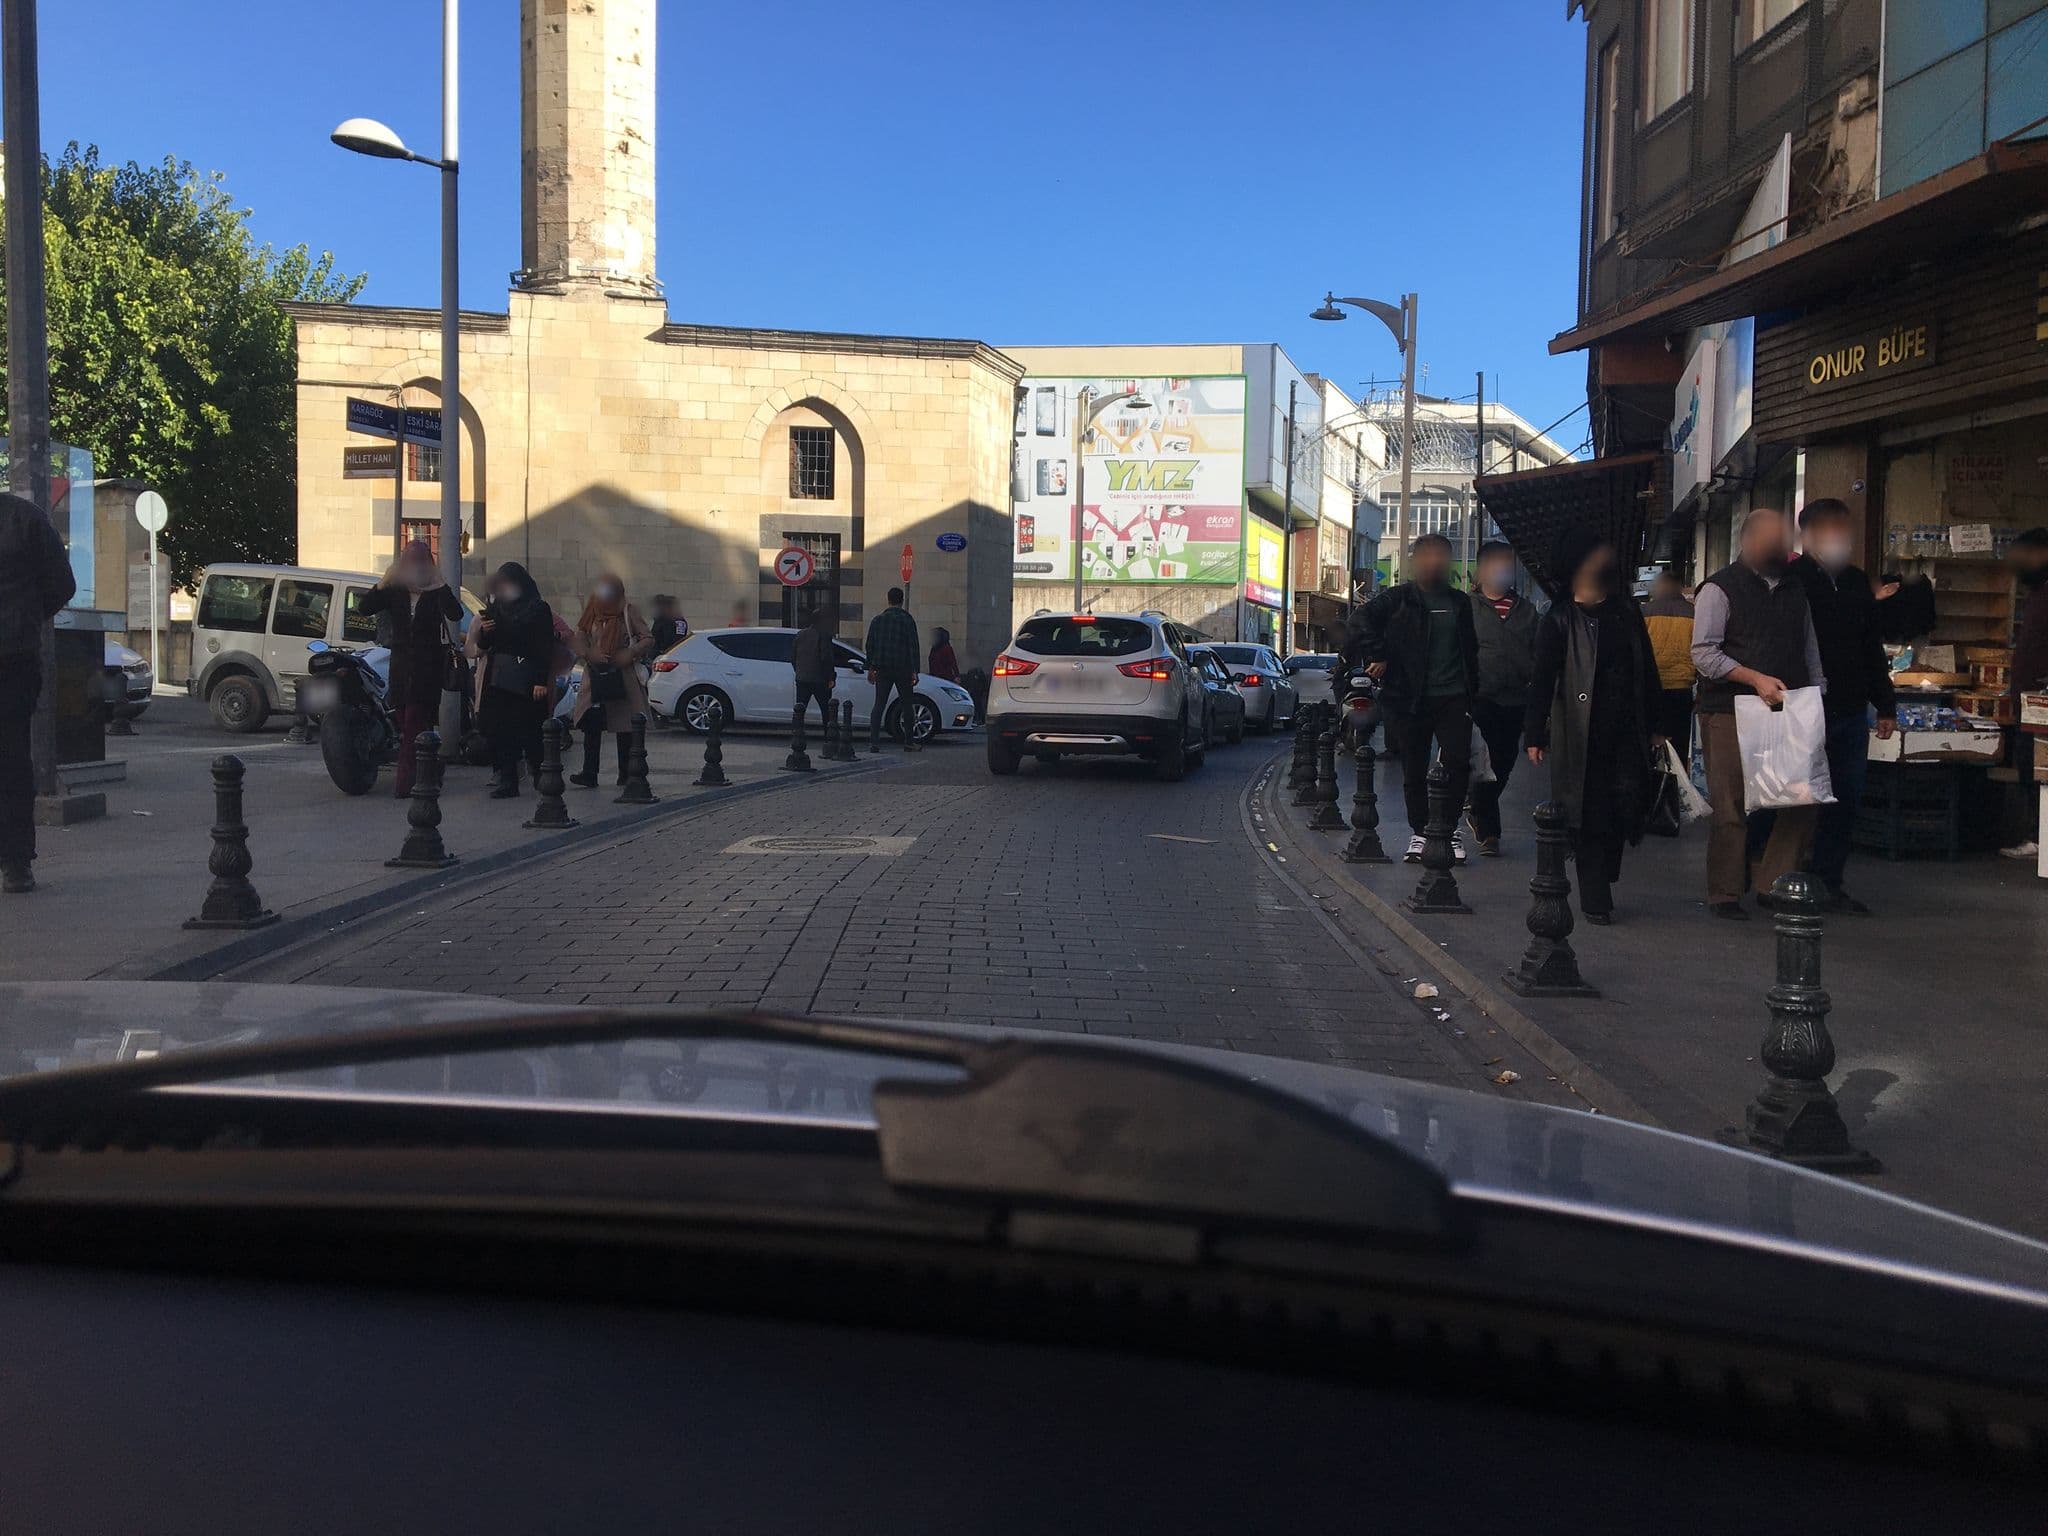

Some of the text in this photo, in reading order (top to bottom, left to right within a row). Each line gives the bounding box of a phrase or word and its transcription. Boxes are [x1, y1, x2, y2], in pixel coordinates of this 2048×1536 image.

[1809, 325, 1927, 384] ONUR BÜFE
[346, 453, 371, 464] MİLLET
[1104, 460, 1200, 490] YMZ
[1206, 515, 1235, 524] ekran
[1302, 537, 1311, 584] YILMAZ
